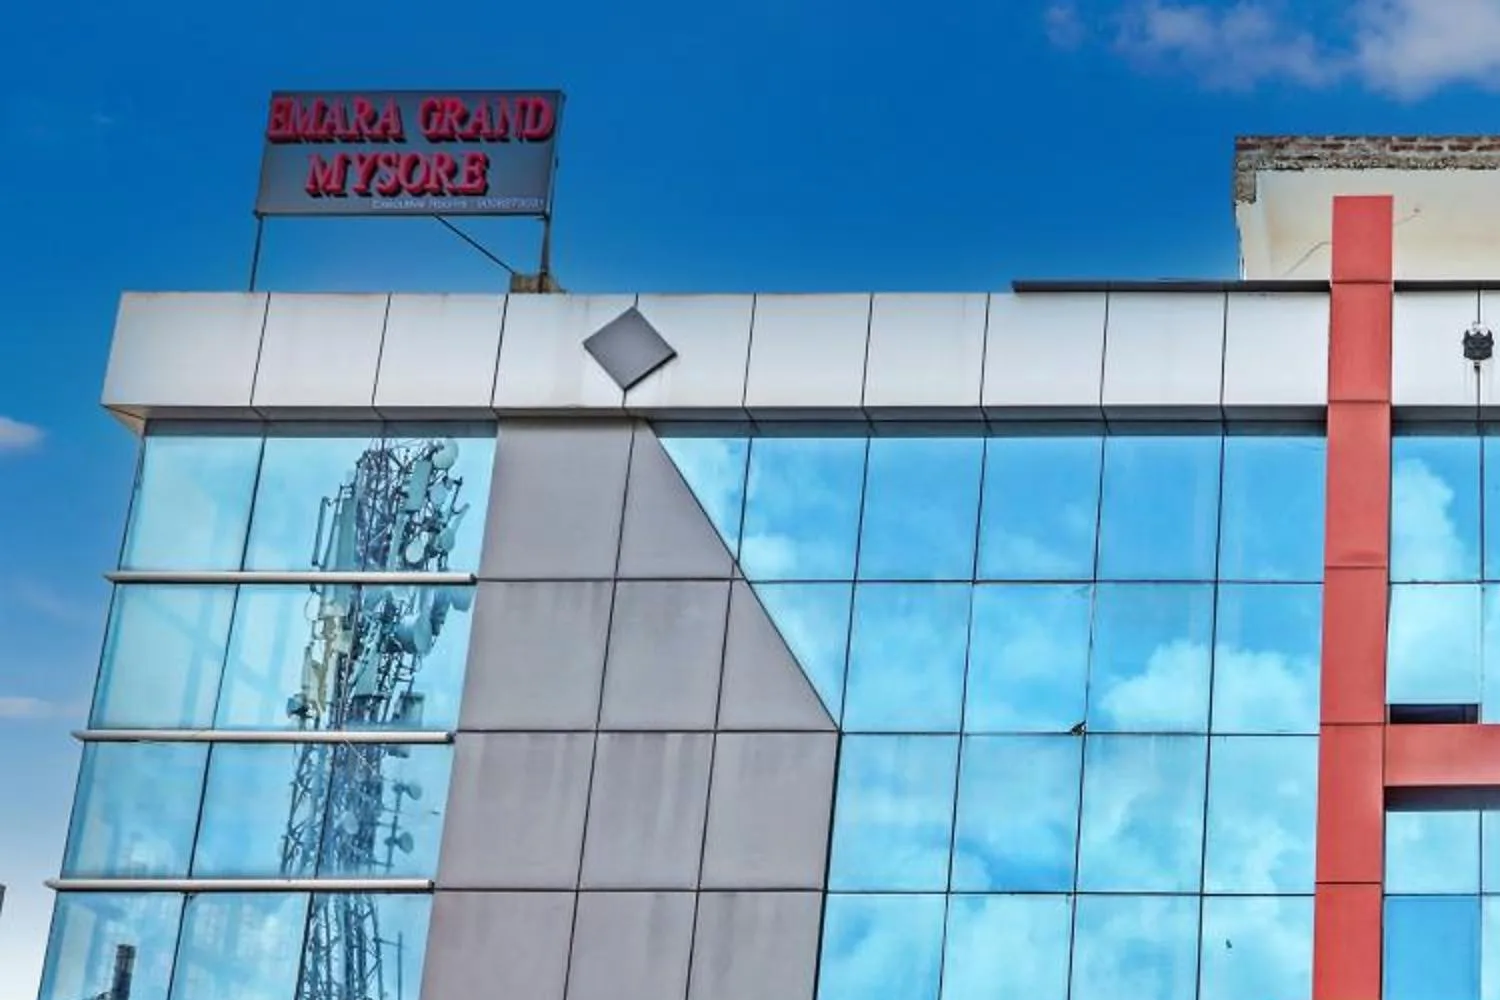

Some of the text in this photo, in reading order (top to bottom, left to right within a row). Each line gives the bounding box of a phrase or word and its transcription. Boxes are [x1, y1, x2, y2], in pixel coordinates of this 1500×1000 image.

[267, 96, 556, 141] EMARA GRAND
[305, 152, 489, 196] MYSORE
